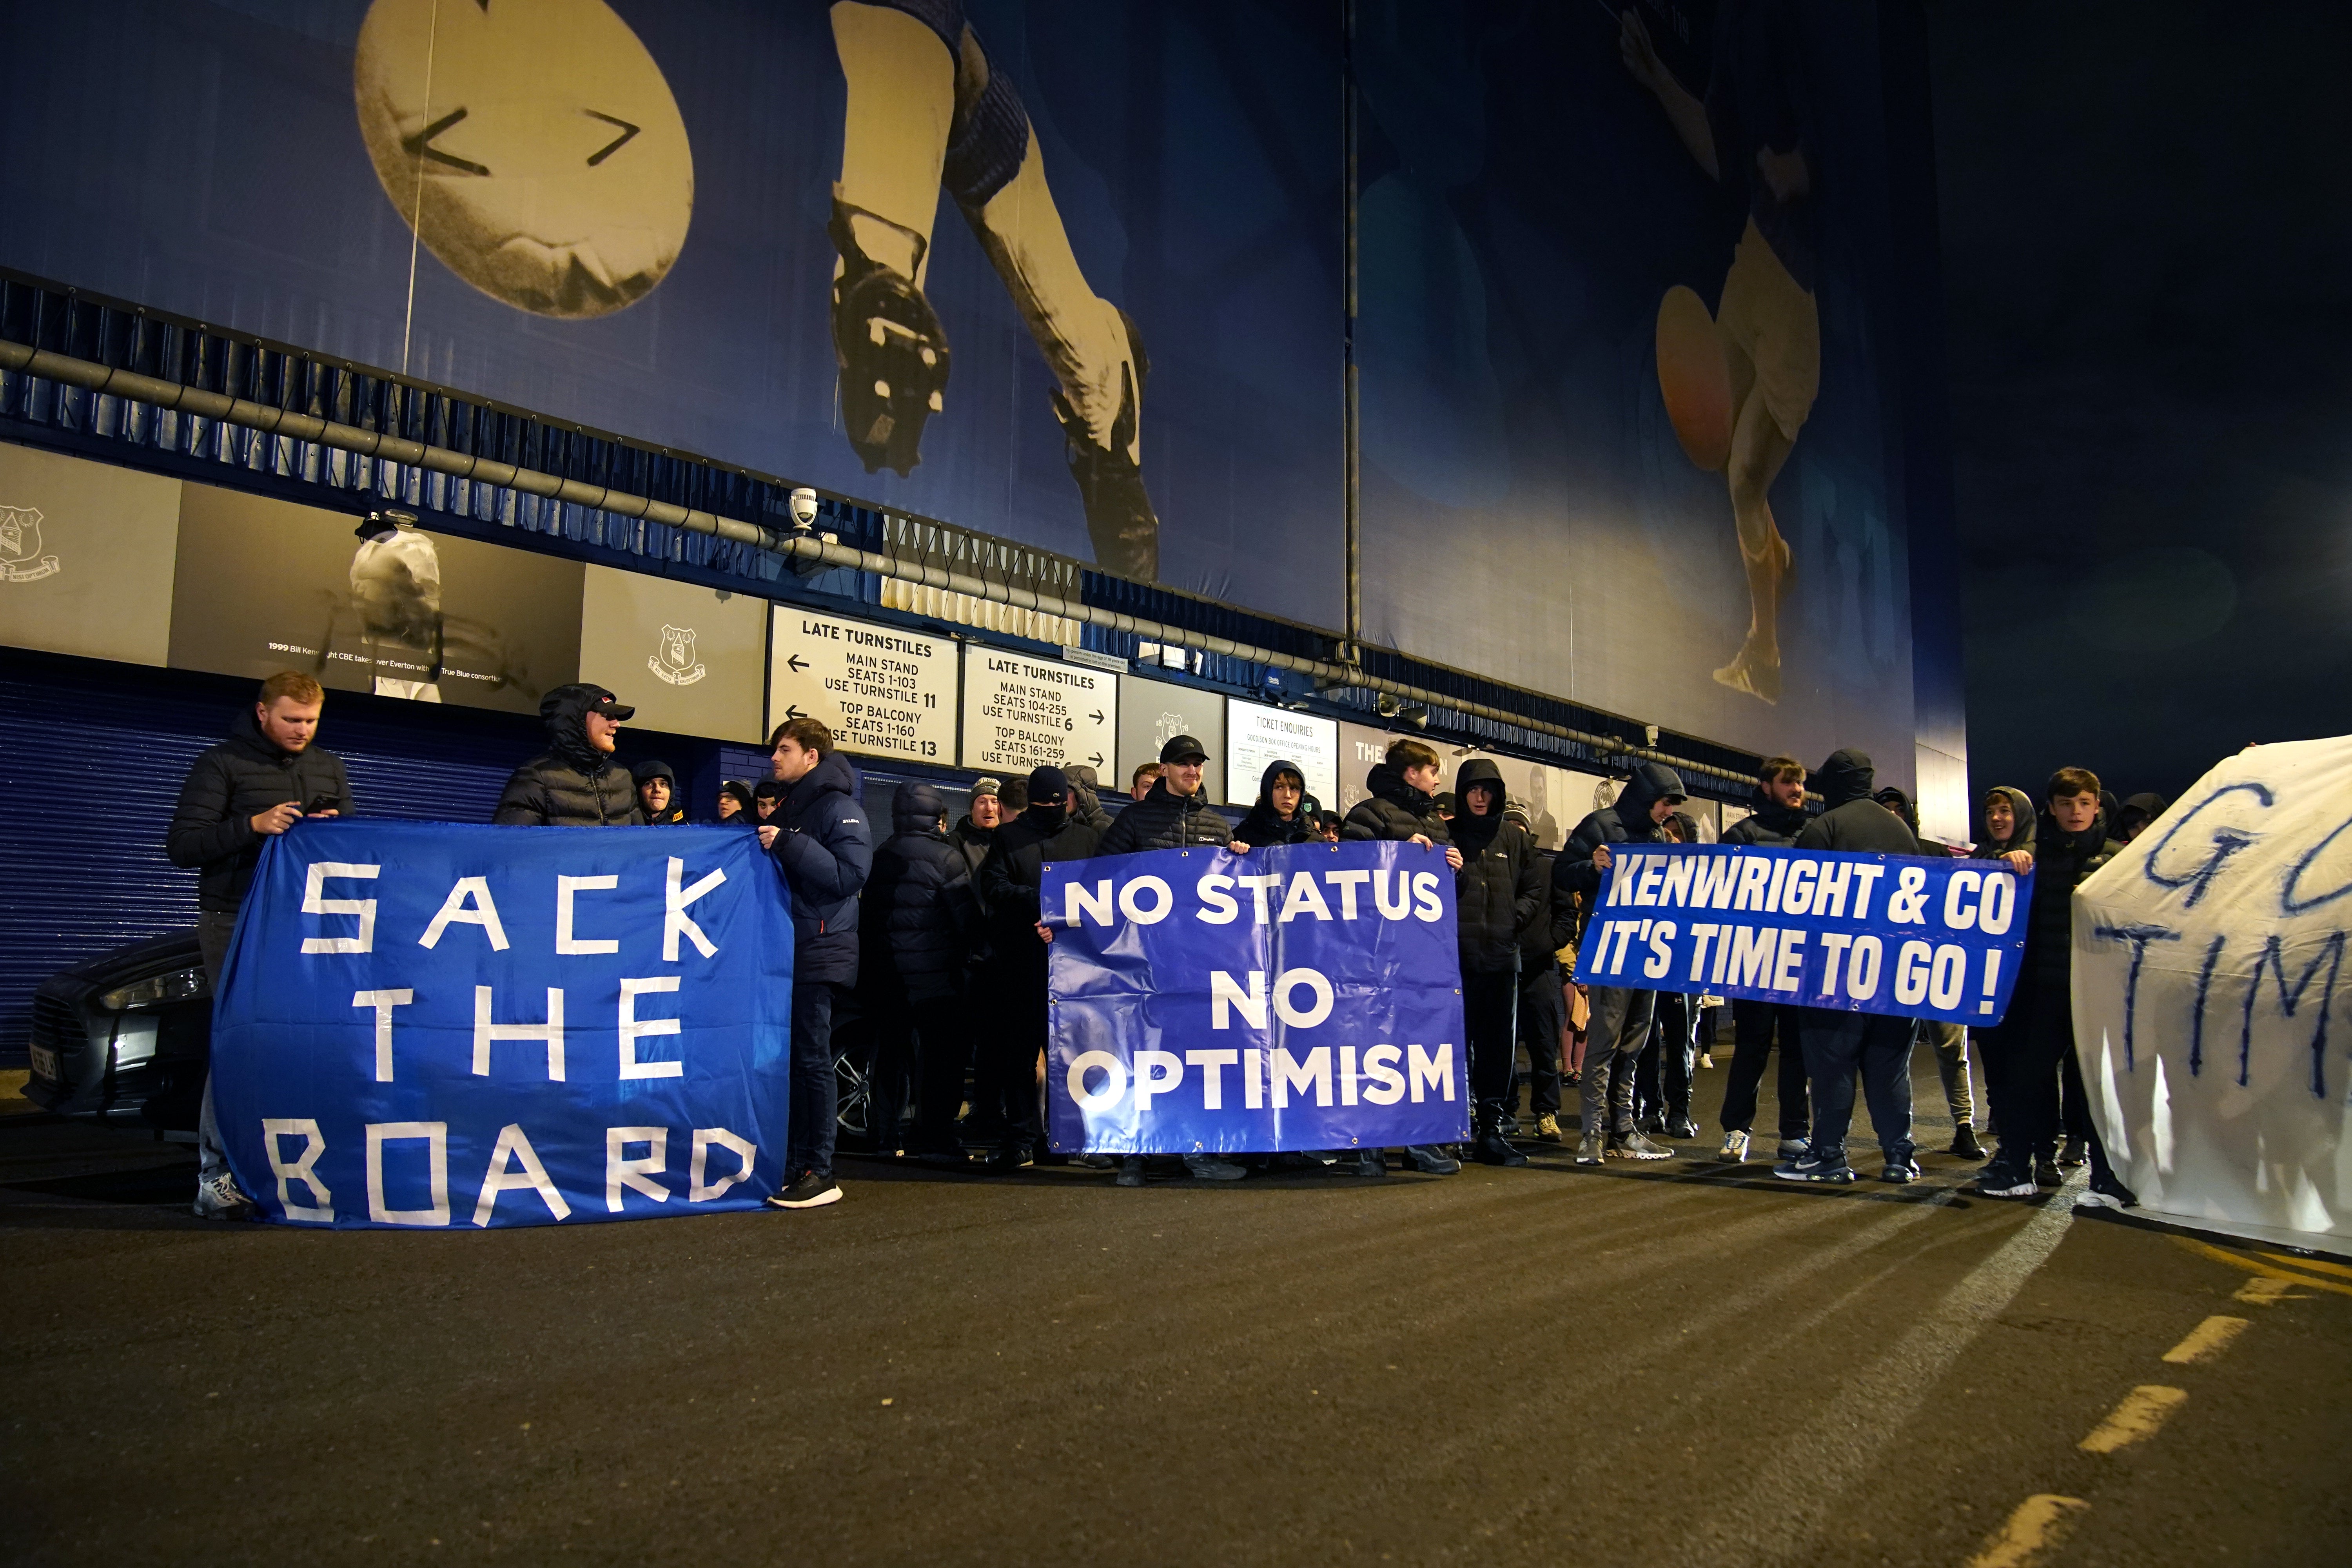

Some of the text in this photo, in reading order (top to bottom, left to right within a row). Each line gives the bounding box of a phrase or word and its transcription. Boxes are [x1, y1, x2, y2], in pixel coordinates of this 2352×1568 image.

[25, 568, 49, 579] OPTIMUM
[803, 620, 932, 658] LATE TURNSTILES
[269, 642, 289, 651] 1999
[290, 645, 301, 653] Bill
[303, 647, 338, 659] Kenwght
[339, 652, 354, 661] CBE
[354, 655, 372, 664] takes
[390, 660, 415, 670] Everton
[441, 668, 455, 676] True
[456, 670, 470, 678] Blue
[846, 652, 918, 676] MAIN STAND
[686, 673, 700, 683] OPTIMUM
[848, 667, 916, 689] SEATS 1-103
[989, 658, 1094, 690] LATE TURNSTILES
[825, 677, 936, 708] USE TURNSTILE 11
[1000, 682, 1061, 702] MAIN STAND
[840, 701, 922, 724] TOP BALCONY
[994, 694, 1067, 716] SEATS 104-255
[846, 717, 915, 737] SEATS 1-160
[983, 705, 1073, 731] USE TURNSTILE 6
[1182, 724, 1189, 733] 78
[1256, 716, 1313, 737] TICKET ENQUIRIES
[830, 729, 936, 757] SE TURNSTILE 13
[996, 726, 1064, 746] TOP BALCONY
[1247, 734, 1267, 744] GOODISON
[1277, 739, 1290, 748] OFFICE
[1291, 742, 1307, 751] OPENING
[1308, 745, 1321, 753] HOURS
[982, 751, 1002, 763] USE
[995, 740, 1065, 759] SEATS 161-259
[1355, 741, 1383, 764] THE
[1065, 869, 1443, 928] NO STATUS
[1606, 853, 2016, 935] KENWRIGHT & CO
[301, 856, 727, 962] SACK
[1591, 919, 1677, 979] IT'S
[1690, 923, 1807, 993] TIME
[1820, 932, 1883, 1000] TO
[1895, 940, 1967, 1011] GO
[1210, 967, 1334, 1030] NO
[2095, 925, 2352, 1098] TIM
[352, 976, 683, 1082] THE
[1066, 1043, 1456, 1112] OPTIMISM
[261, 1118, 758, 1228] BOARD
